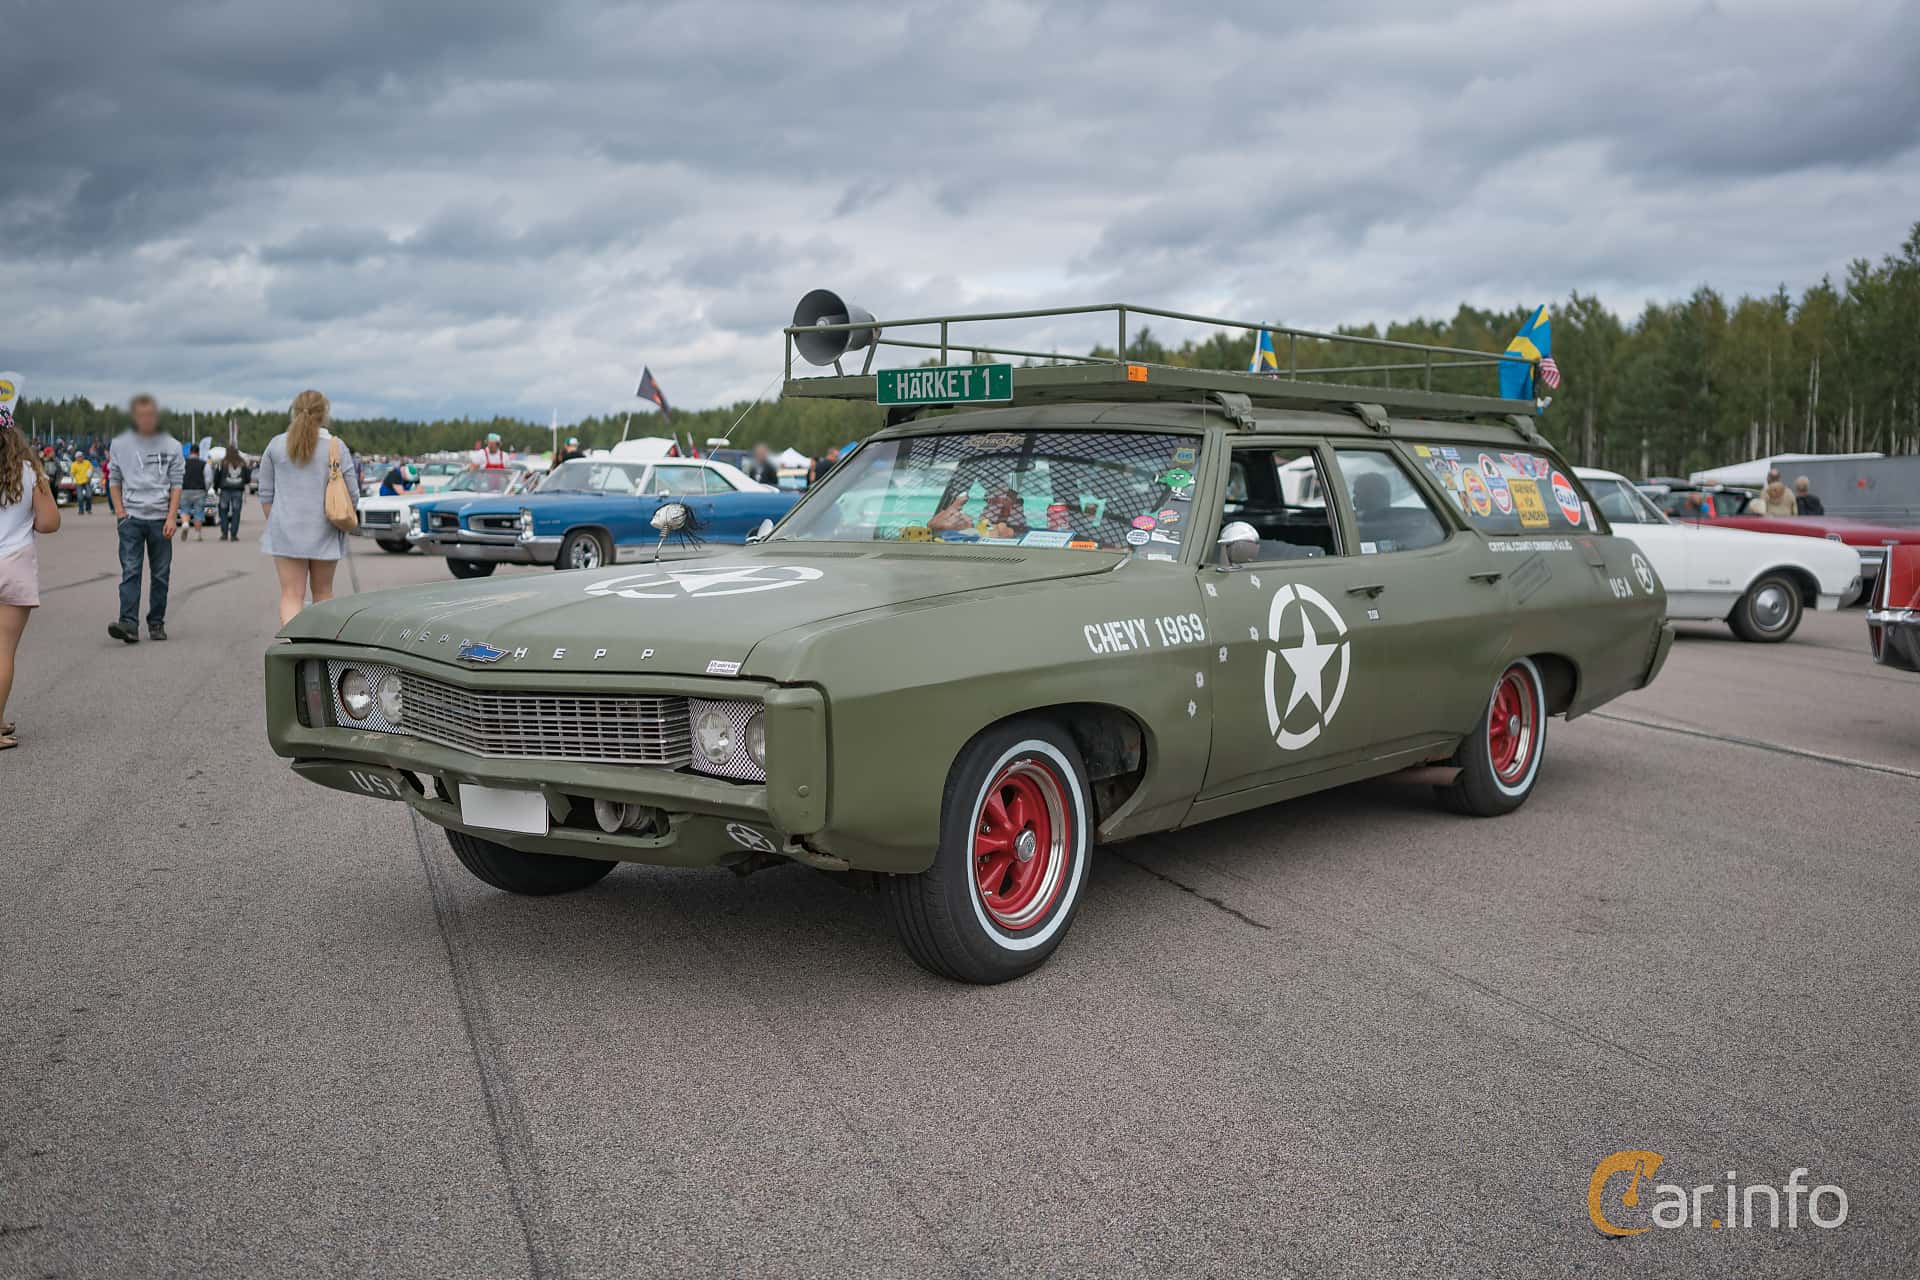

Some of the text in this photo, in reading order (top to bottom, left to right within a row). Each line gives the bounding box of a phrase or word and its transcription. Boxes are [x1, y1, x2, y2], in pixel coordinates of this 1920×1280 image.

[896, 368, 991, 400] HÄRKET 1
[1554, 487, 1579, 508] Gulf
[1609, 576, 1634, 598] USA
[1083, 613, 1206, 654] CHEVY 1969
[513, 647, 655, 660] HEPP
